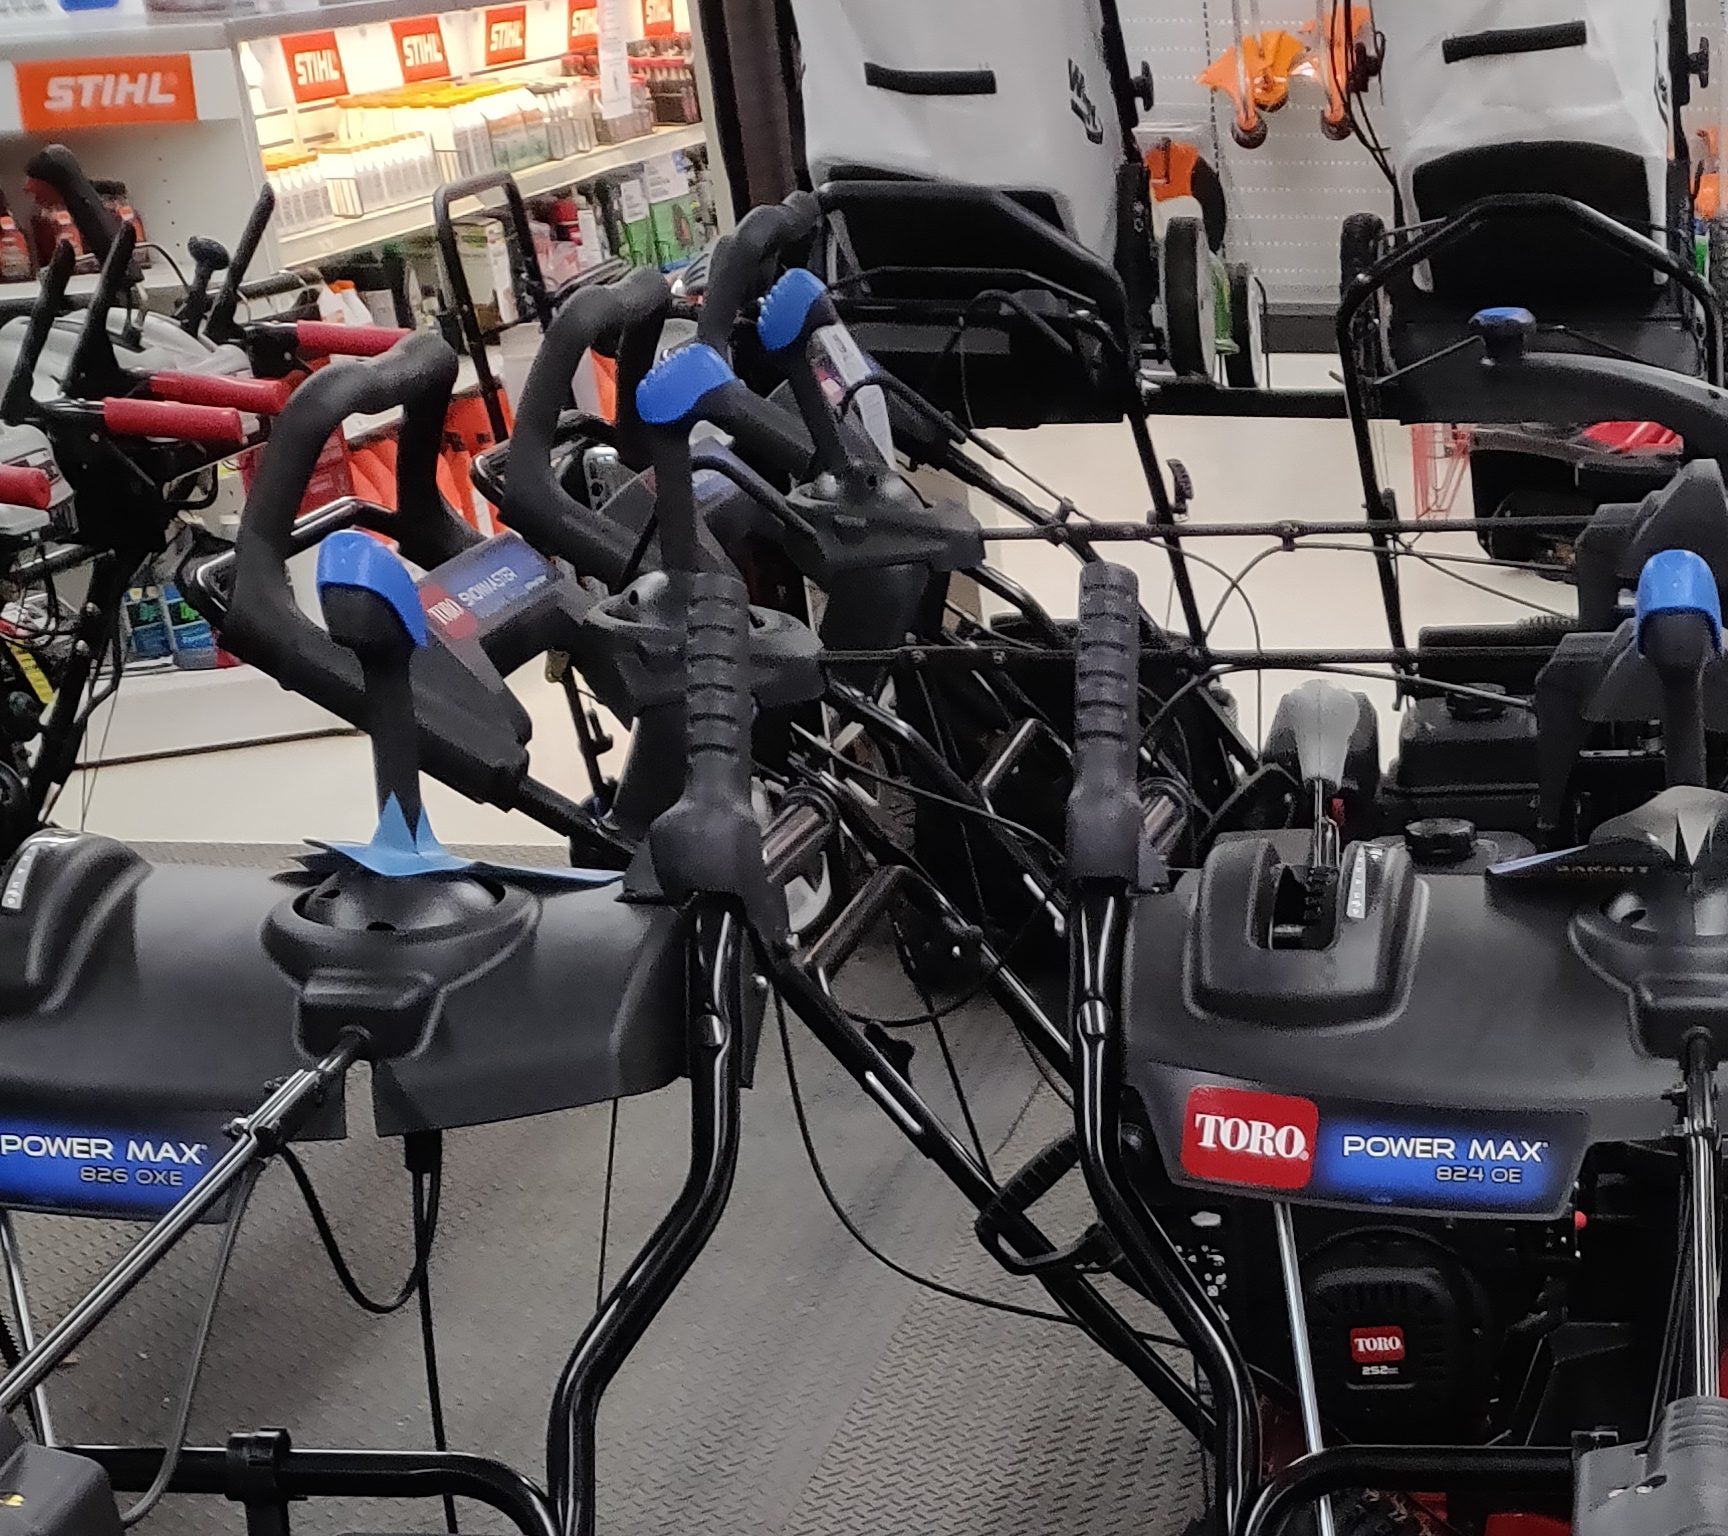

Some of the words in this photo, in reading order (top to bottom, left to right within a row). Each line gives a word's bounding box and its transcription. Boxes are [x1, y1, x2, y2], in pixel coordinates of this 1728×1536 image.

[402, 32, 444, 68] STIHL
[490, 20, 523, 52] STIHL
[295, 49, 341, 86] STIHL
[44, 72, 176, 112] STIHL
[0, 1134, 113, 1160] POWER
[126, 1139, 202, 1165] MAX
[1195, 1112, 1304, 1159] TORO
[1343, 1136, 1457, 1159] POWER
[1467, 1138, 1543, 1162] MAX
[80, 1166, 129, 1183] 826
[135, 1169, 184, 1186] OXE
[1436, 1166, 1484, 1182] 824
[1490, 1167, 1522, 1183] OE
[1354, 1335, 1401, 1353] TORO
